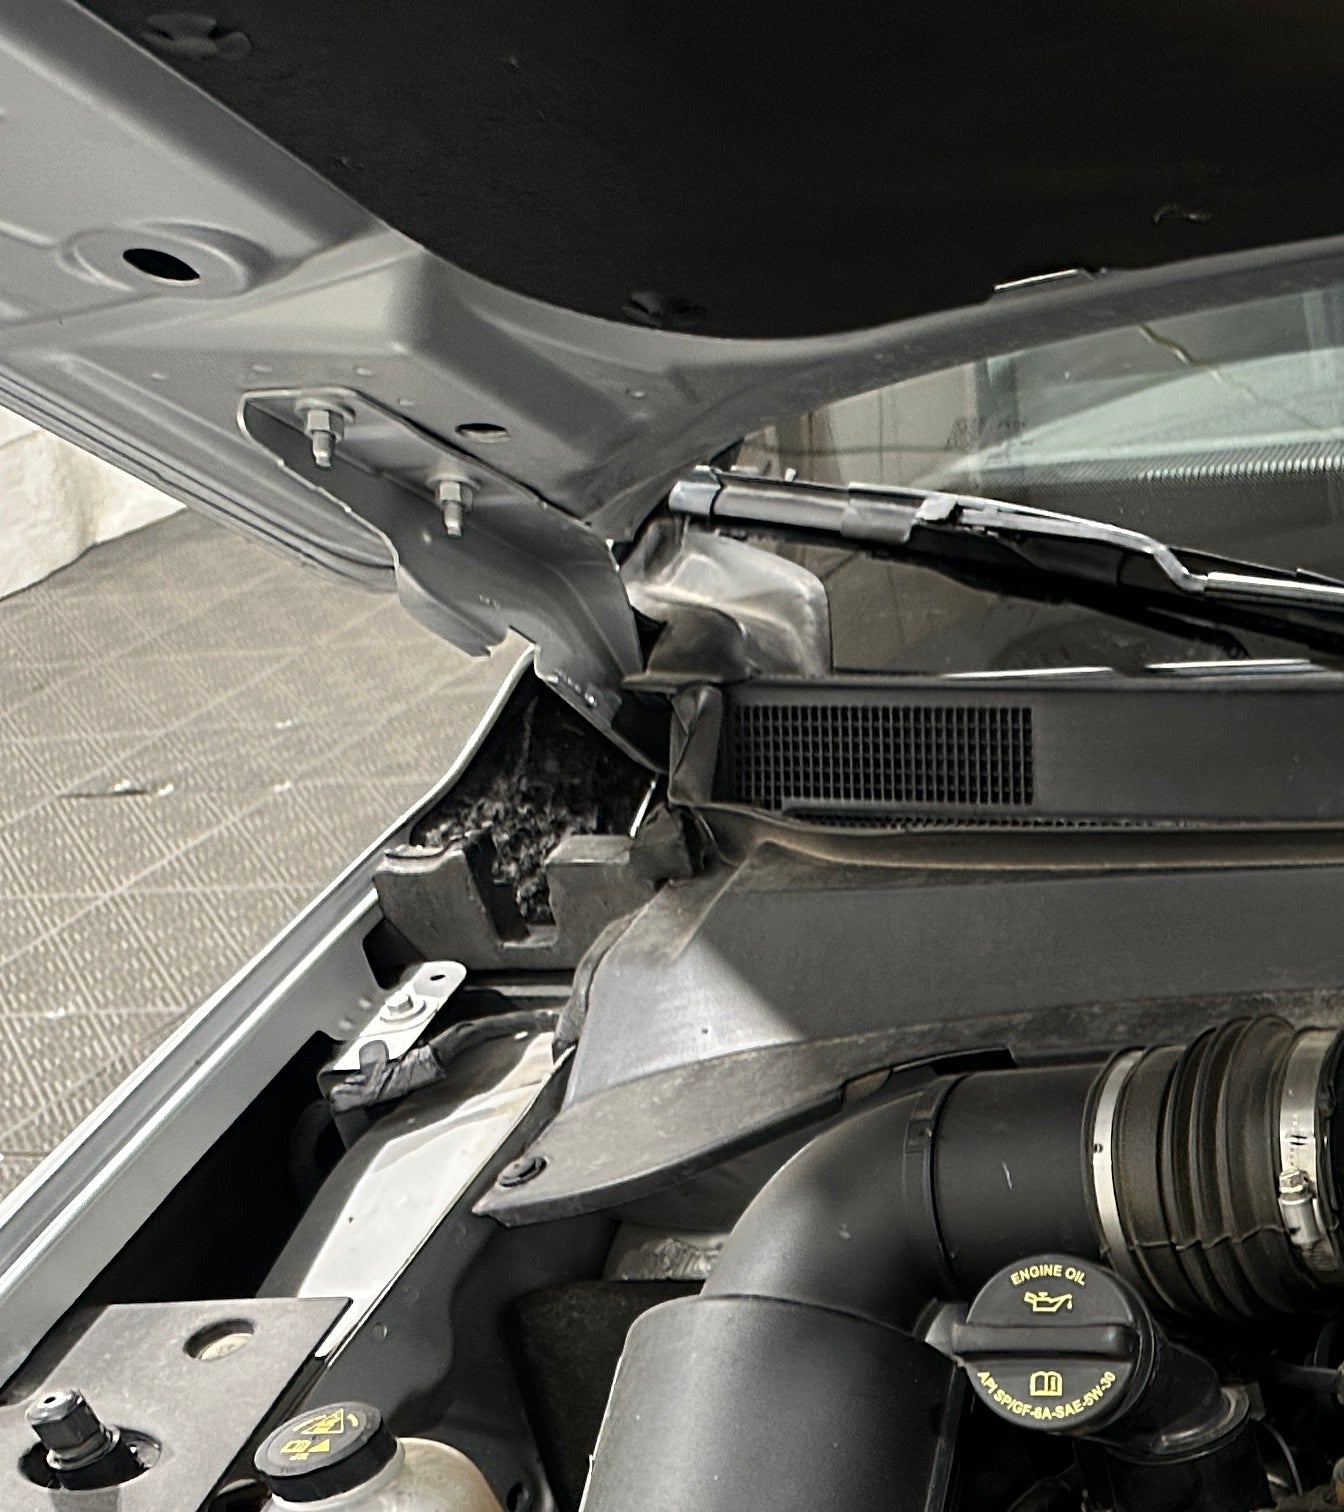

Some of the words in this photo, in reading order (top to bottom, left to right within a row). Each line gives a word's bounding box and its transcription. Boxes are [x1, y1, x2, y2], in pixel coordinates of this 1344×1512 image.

[1010, 1264, 1062, 1287] ENGINE
[1065, 1266, 1087, 1287] OIL
[977, 1370, 995, 1394] API
